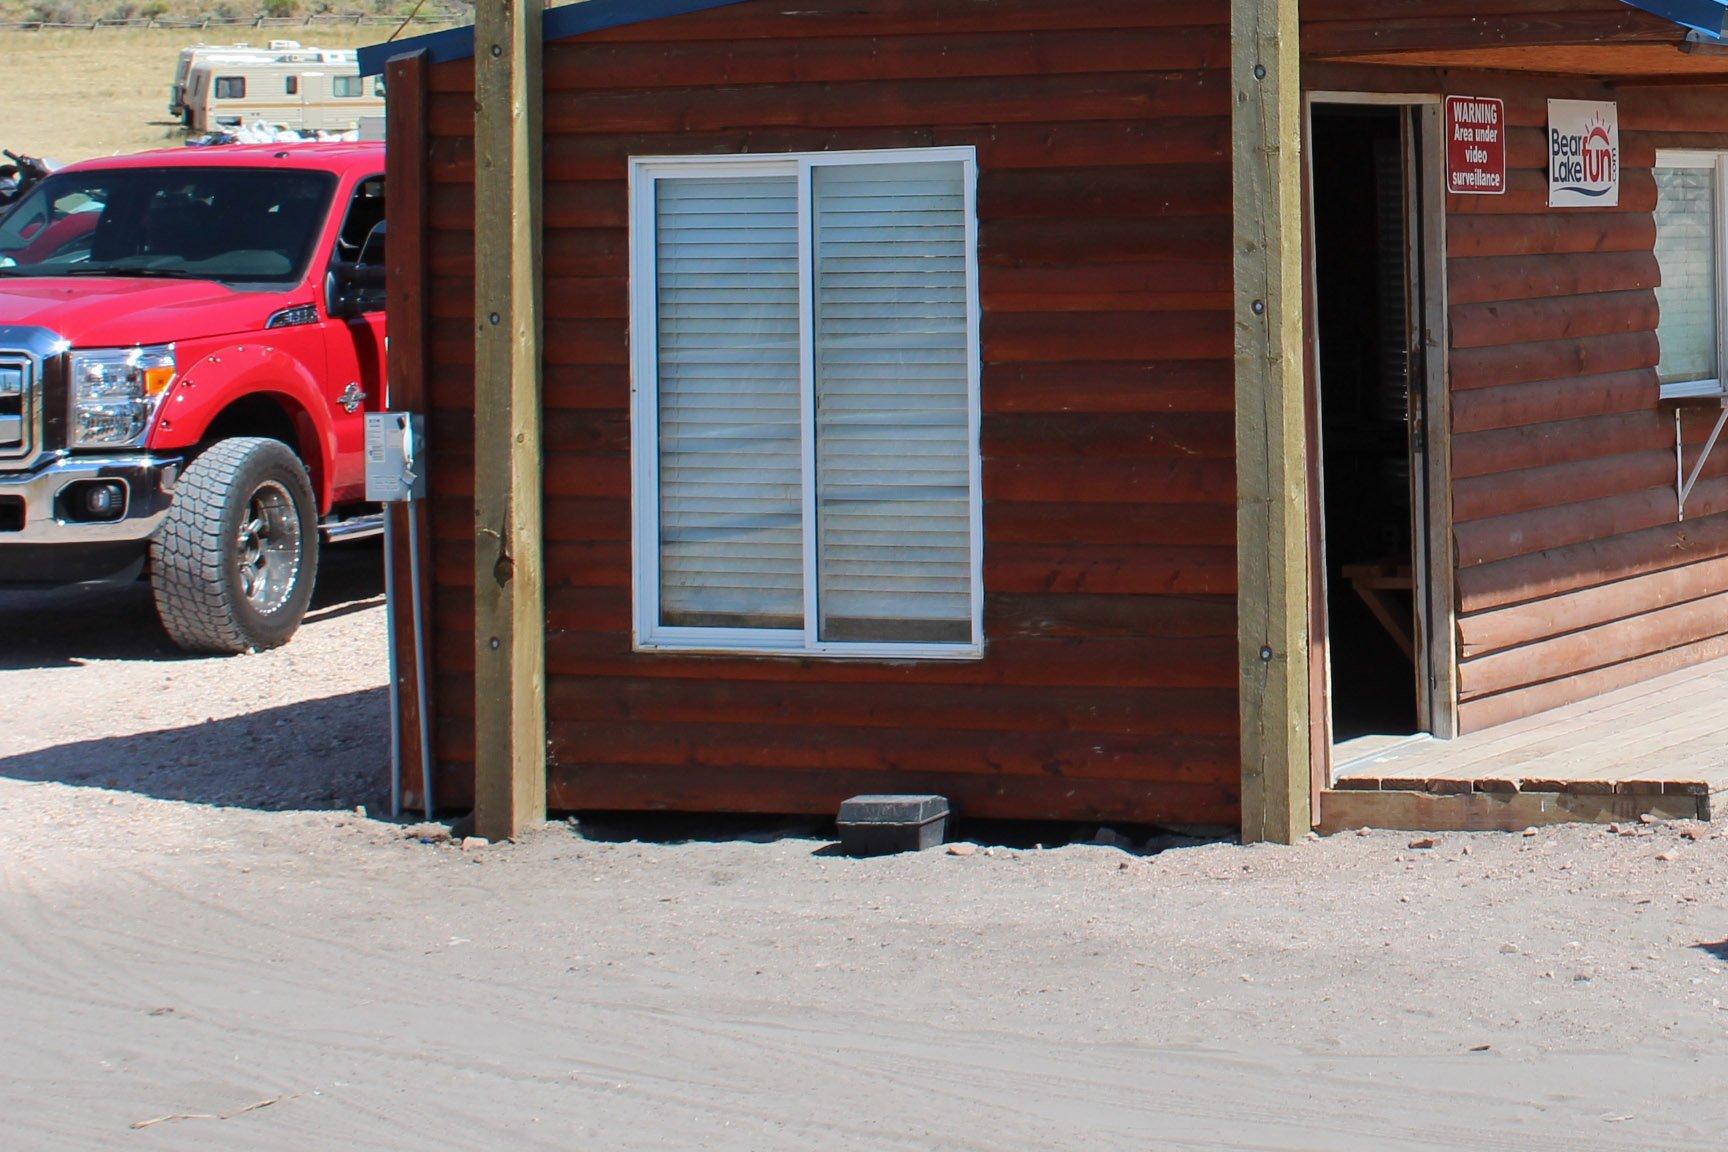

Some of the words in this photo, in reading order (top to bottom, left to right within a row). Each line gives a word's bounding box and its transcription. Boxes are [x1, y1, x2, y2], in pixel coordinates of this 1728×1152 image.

[1453, 101, 1498, 124] WARNING
[1454, 124, 1473, 142] Area
[1475, 125, 1498, 143] under
[1551, 128, 1582, 156] Bear
[1464, 145, 1488, 163] video
[1551, 156, 1582, 183] Lake
[1581, 135, 1612, 183] fun
[1452, 168, 1500, 187] surveillance
